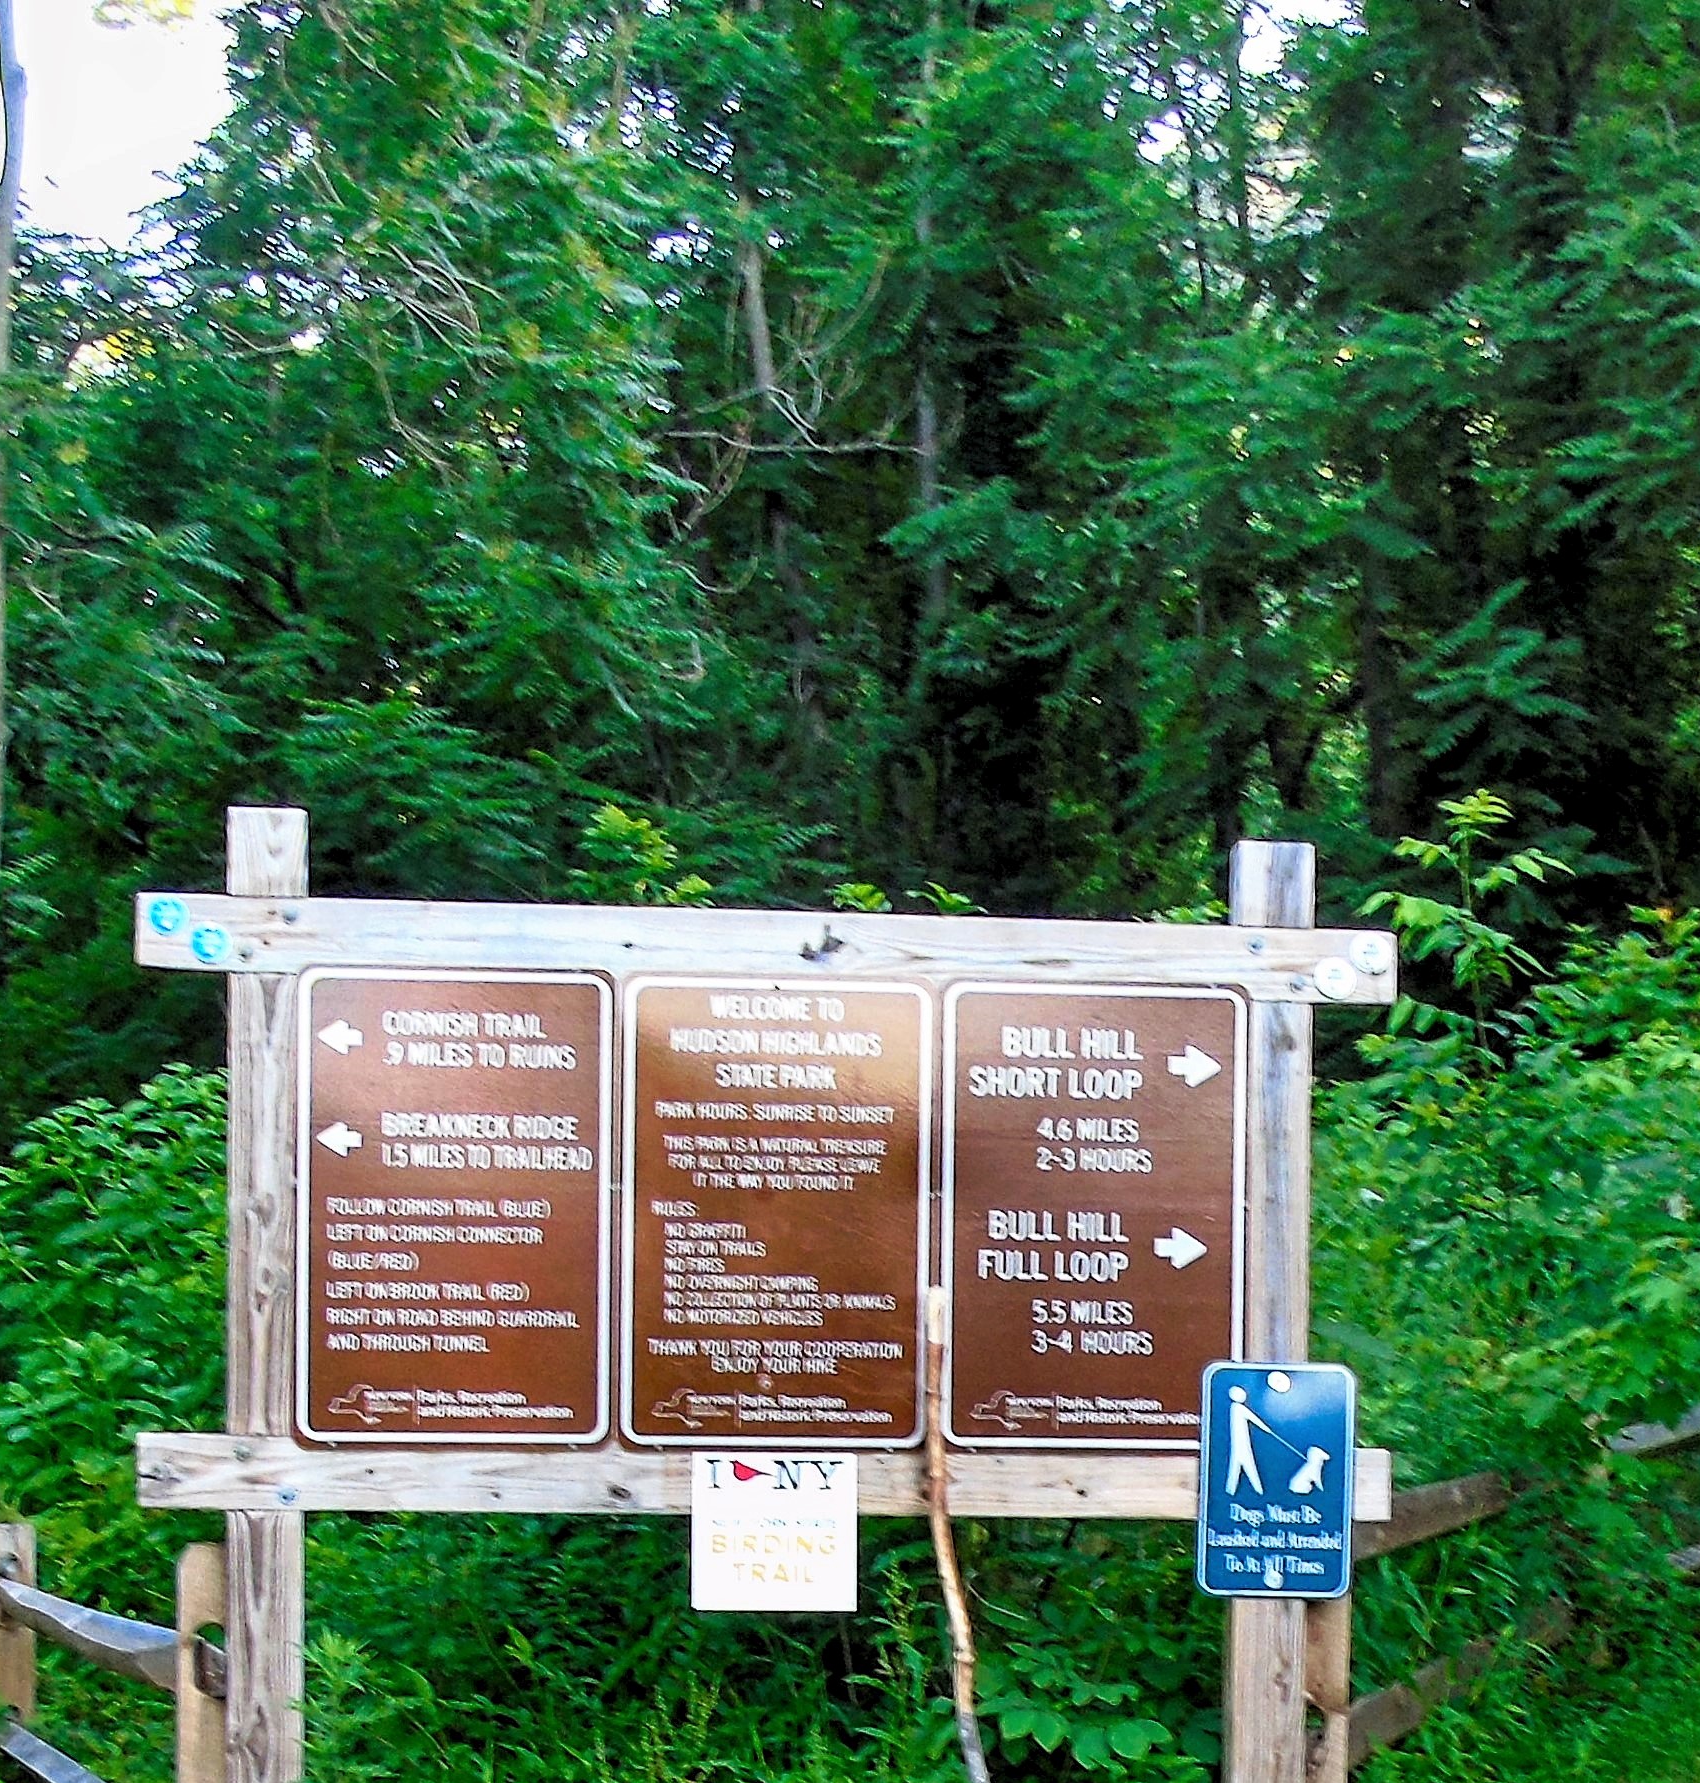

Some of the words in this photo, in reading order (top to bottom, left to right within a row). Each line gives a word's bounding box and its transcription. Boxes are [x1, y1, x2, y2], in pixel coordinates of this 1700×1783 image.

[710, 994, 812, 1020] WELCOME
[818, 997, 845, 1021] TO
[381, 1010, 478, 1037] CORNISH
[482, 1012, 547, 1039] TRAIL
[670, 1028, 759, 1054] HUDSON
[760, 1030, 882, 1056] HIGHLANDS
[1001, 1026, 1076, 1059] BULL
[1080, 1028, 1144, 1060] HILL
[407, 1042, 473, 1068] MILES
[476, 1043, 505, 1068] TO
[509, 1044, 577, 1070] RUINS
[715, 1063, 778, 1088] STATE
[780, 1065, 837, 1090] PARK
[968, 1065, 1062, 1098] SHORT
[1068, 1067, 1143, 1100] LOOP
[655, 1101, 695, 1119] PARK
[753, 1103, 816, 1122] SUNRISE
[817, 1104, 836, 1122] TO
[838, 1105, 895, 1124] SUNSET
[381, 1111, 511, 1139] BREAKNECK
[513, 1114, 579, 1141] RIDGE
[1037, 1117, 1072, 1142] 4.6
[1076, 1118, 1140, 1143] MILES
[381, 1143, 407, 1168] 1.5
[410, 1144, 465, 1169] MILES
[468, 1145, 490, 1170] TO
[493, 1145, 593, 1171] TRAILHEAD
[1036, 1147, 1076, 1172] 2-3
[1079, 1148, 1152, 1174] HOURS
[327, 1197, 386, 1215] FOLLOW
[388, 1198, 453, 1217] CORNISH
[454, 1199, 498, 1218] TRAIL
[326, 1224, 363, 1241] LEFT
[365, 1225, 388, 1242] ON
[390, 1225, 454, 1243] CORNISH
[456, 1226, 544, 1244] CONNECTOR
[988, 1209, 1061, 1241] BULL
[1067, 1211, 1129, 1242] HILL
[665, 1240, 697, 1255] STAY
[978, 1249, 1049, 1281] FULL
[1054, 1250, 1129, 1282] LOOP
[326, 1281, 363, 1299] LEFT
[365, 1282, 387, 1299] ON
[388, 1282, 440, 1300] BROOK
[441, 1282, 486, 1301] TRAIL
[326, 1308, 371, 1326] RIGHT
[373, 1309, 395, 1326] ON
[397, 1309, 439, 1327] ROAD
[440, 1310, 495, 1327] BEHIND
[497, 1310, 580, 1329] GUARDRAIL
[1031, 1299, 1067, 1324] 5.5
[1070, 1300, 1134, 1325] MILES
[327, 1333, 360, 1350] AND
[362, 1334, 431, 1351] THROUGH
[433, 1335, 490, 1353] TUNNEL
[648, 1339, 698, 1355] THANK
[700, 1340, 730, 1356] YOU
[731, 1340, 761, 1356] FOR
[763, 1341, 802, 1357] YOUR
[1031, 1330, 1074, 1353] 3-4
[1080, 1331, 1153, 1355] HOURS
[761, 1357, 802, 1374] YOUR
[772, 1460, 844, 1490] NY
[1230, 1503, 1265, 1527] Dogs
[1266, 1504, 1300, 1524] Must
[1301, 1505, 1321, 1524] Be
[712, 1534, 836, 1555] BIRDING
[1260, 1530, 1286, 1549] and
[733, 1563, 813, 1583] TRAIL
[1224, 1554, 1243, 1573] To
[1286, 1555, 1325, 1575] Times
